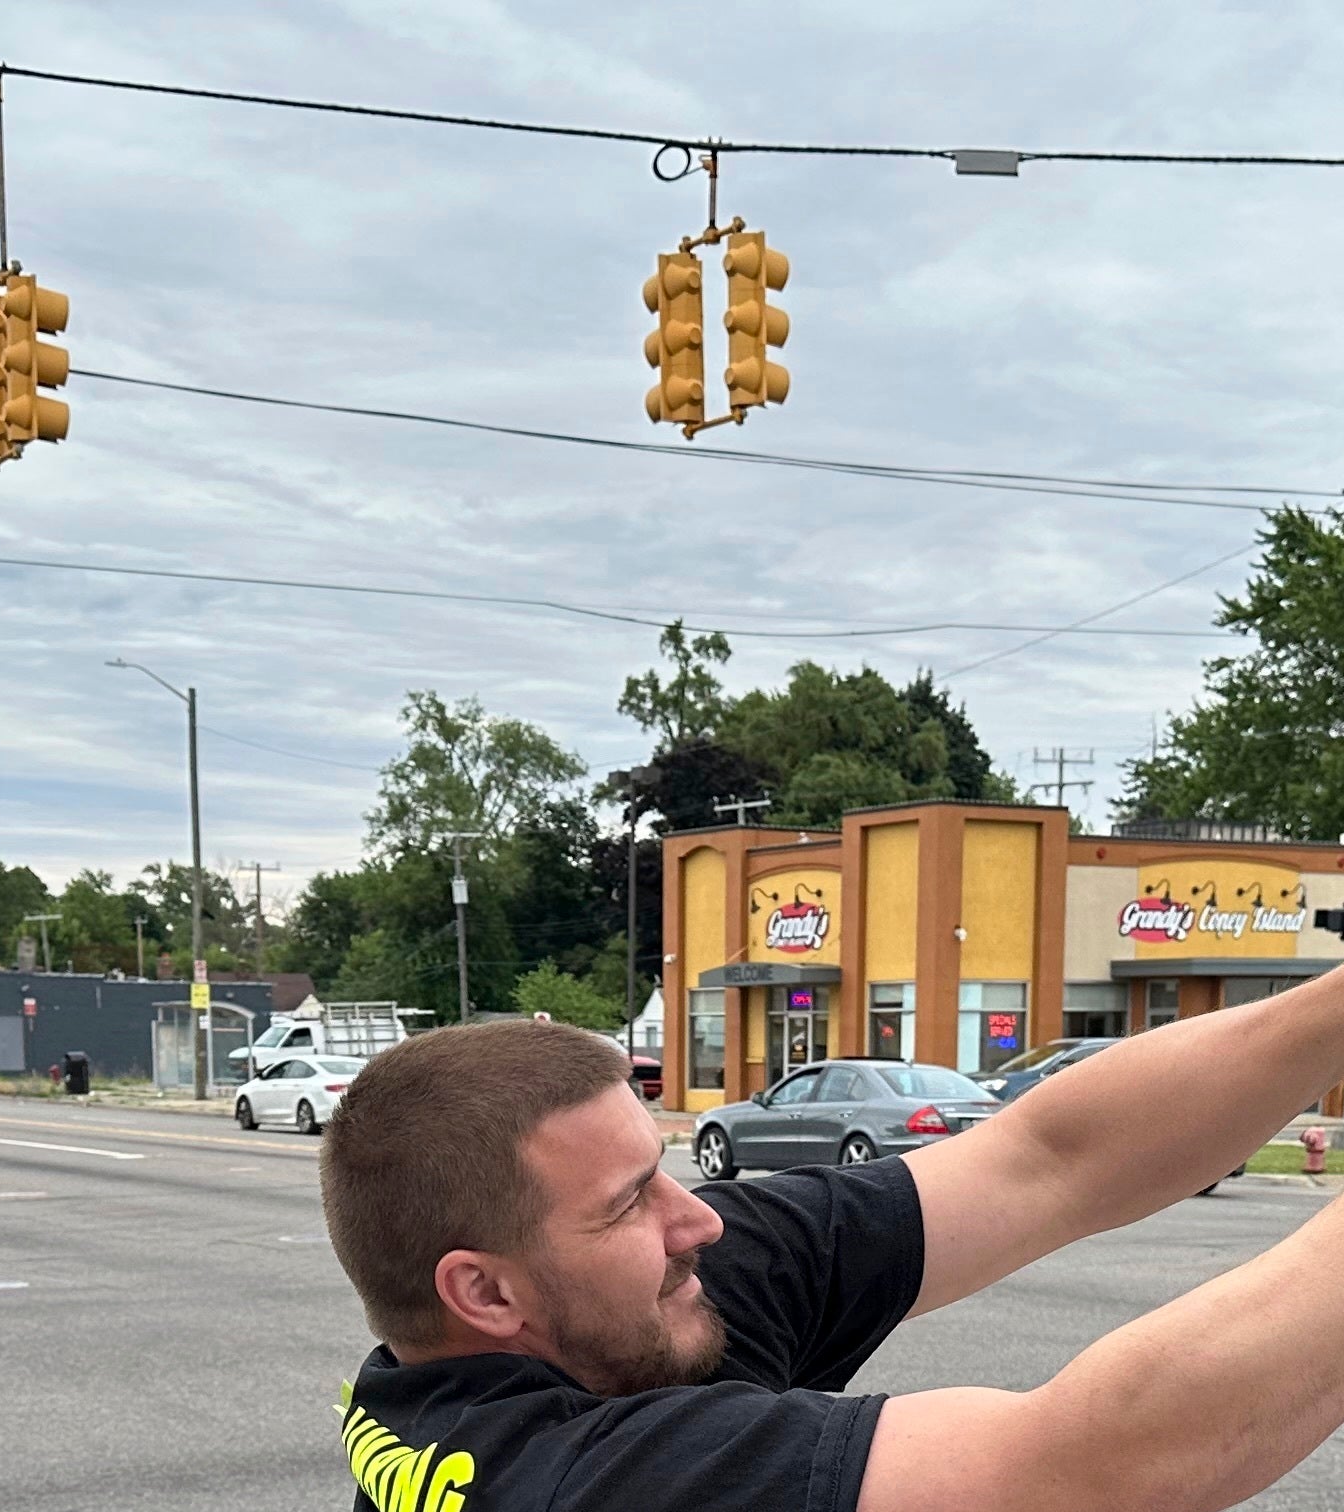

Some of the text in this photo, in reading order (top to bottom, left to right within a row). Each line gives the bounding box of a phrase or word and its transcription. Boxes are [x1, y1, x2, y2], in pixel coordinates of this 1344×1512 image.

[767, 906, 829, 949] Grandy's
[1119, 902, 1306, 940] Grandy's Coney Island
[724, 966, 773, 982] WELCOME
